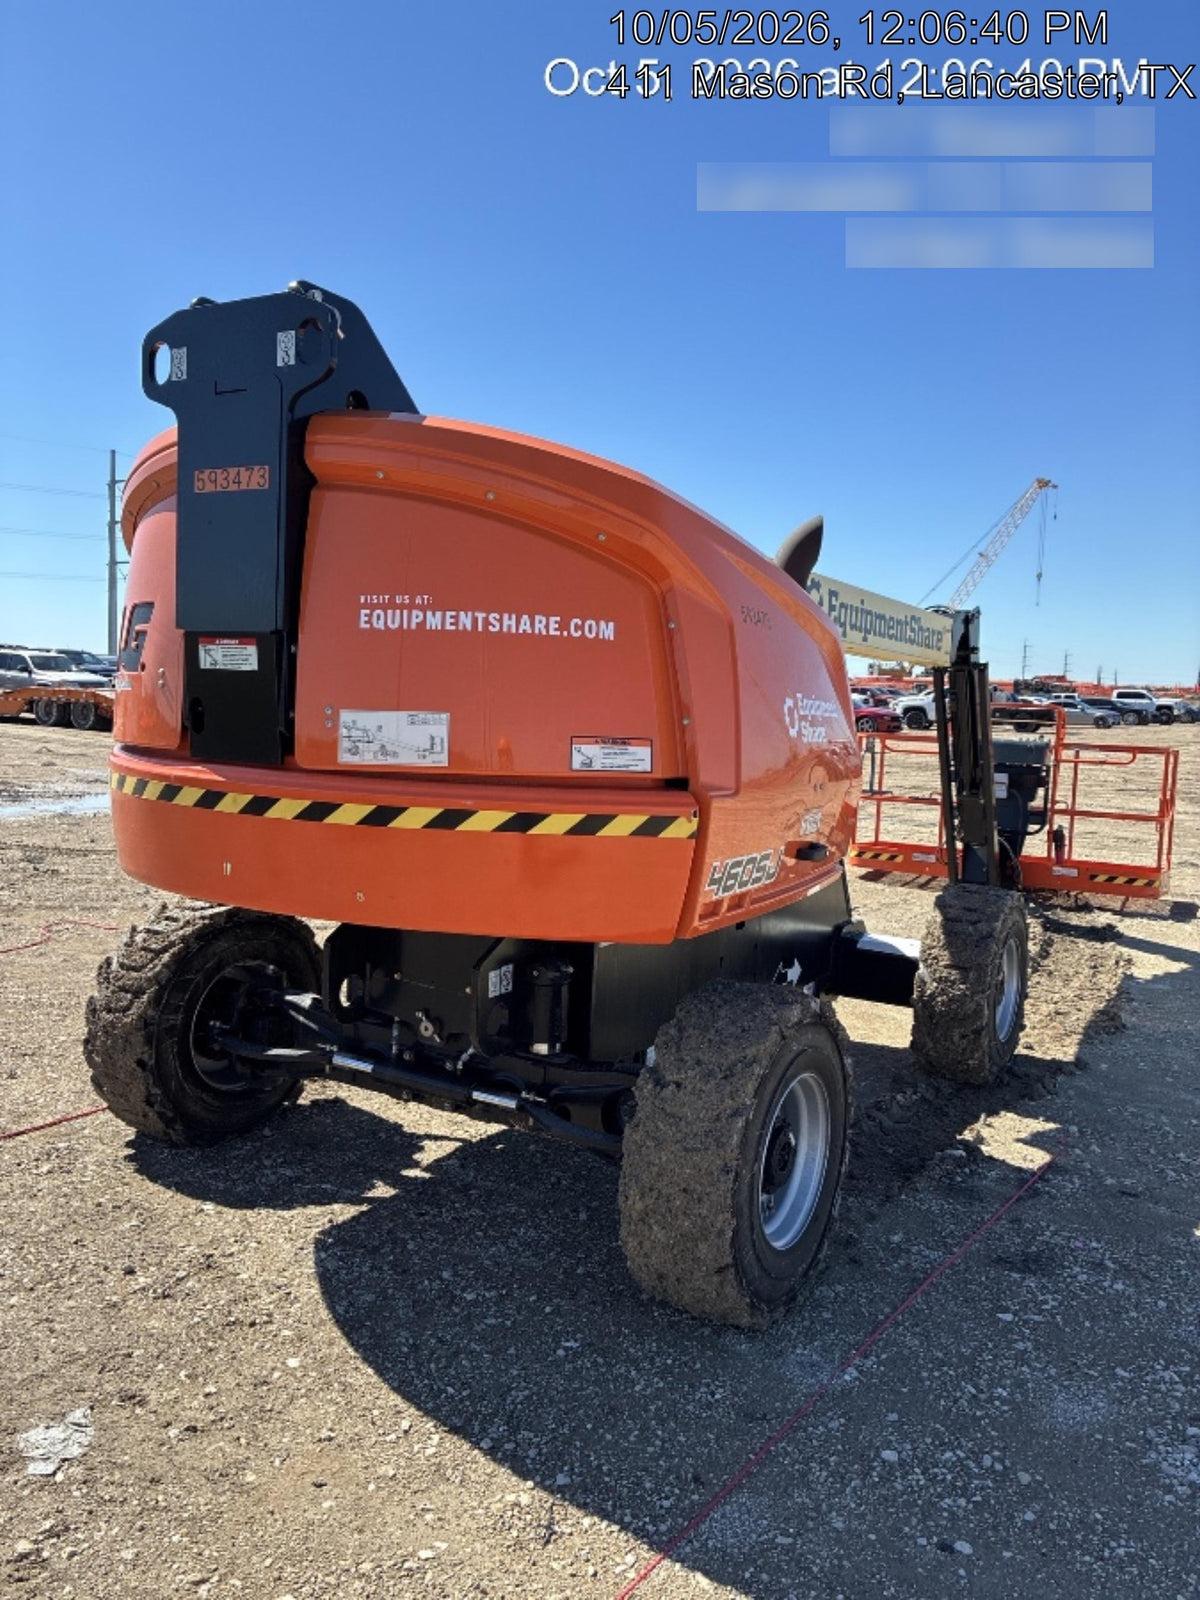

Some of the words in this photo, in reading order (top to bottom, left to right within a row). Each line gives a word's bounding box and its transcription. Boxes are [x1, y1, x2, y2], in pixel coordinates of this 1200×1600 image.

[196, 466, 268, 492] 593473
[360, 594, 391, 604] VISIT
[395, 594, 411, 604] US
[415, 595, 433, 606] AT:
[358, 608, 616, 641] EQUIPMENTSHARE.COM
[828, 588, 943, 652] EquipmentShare
